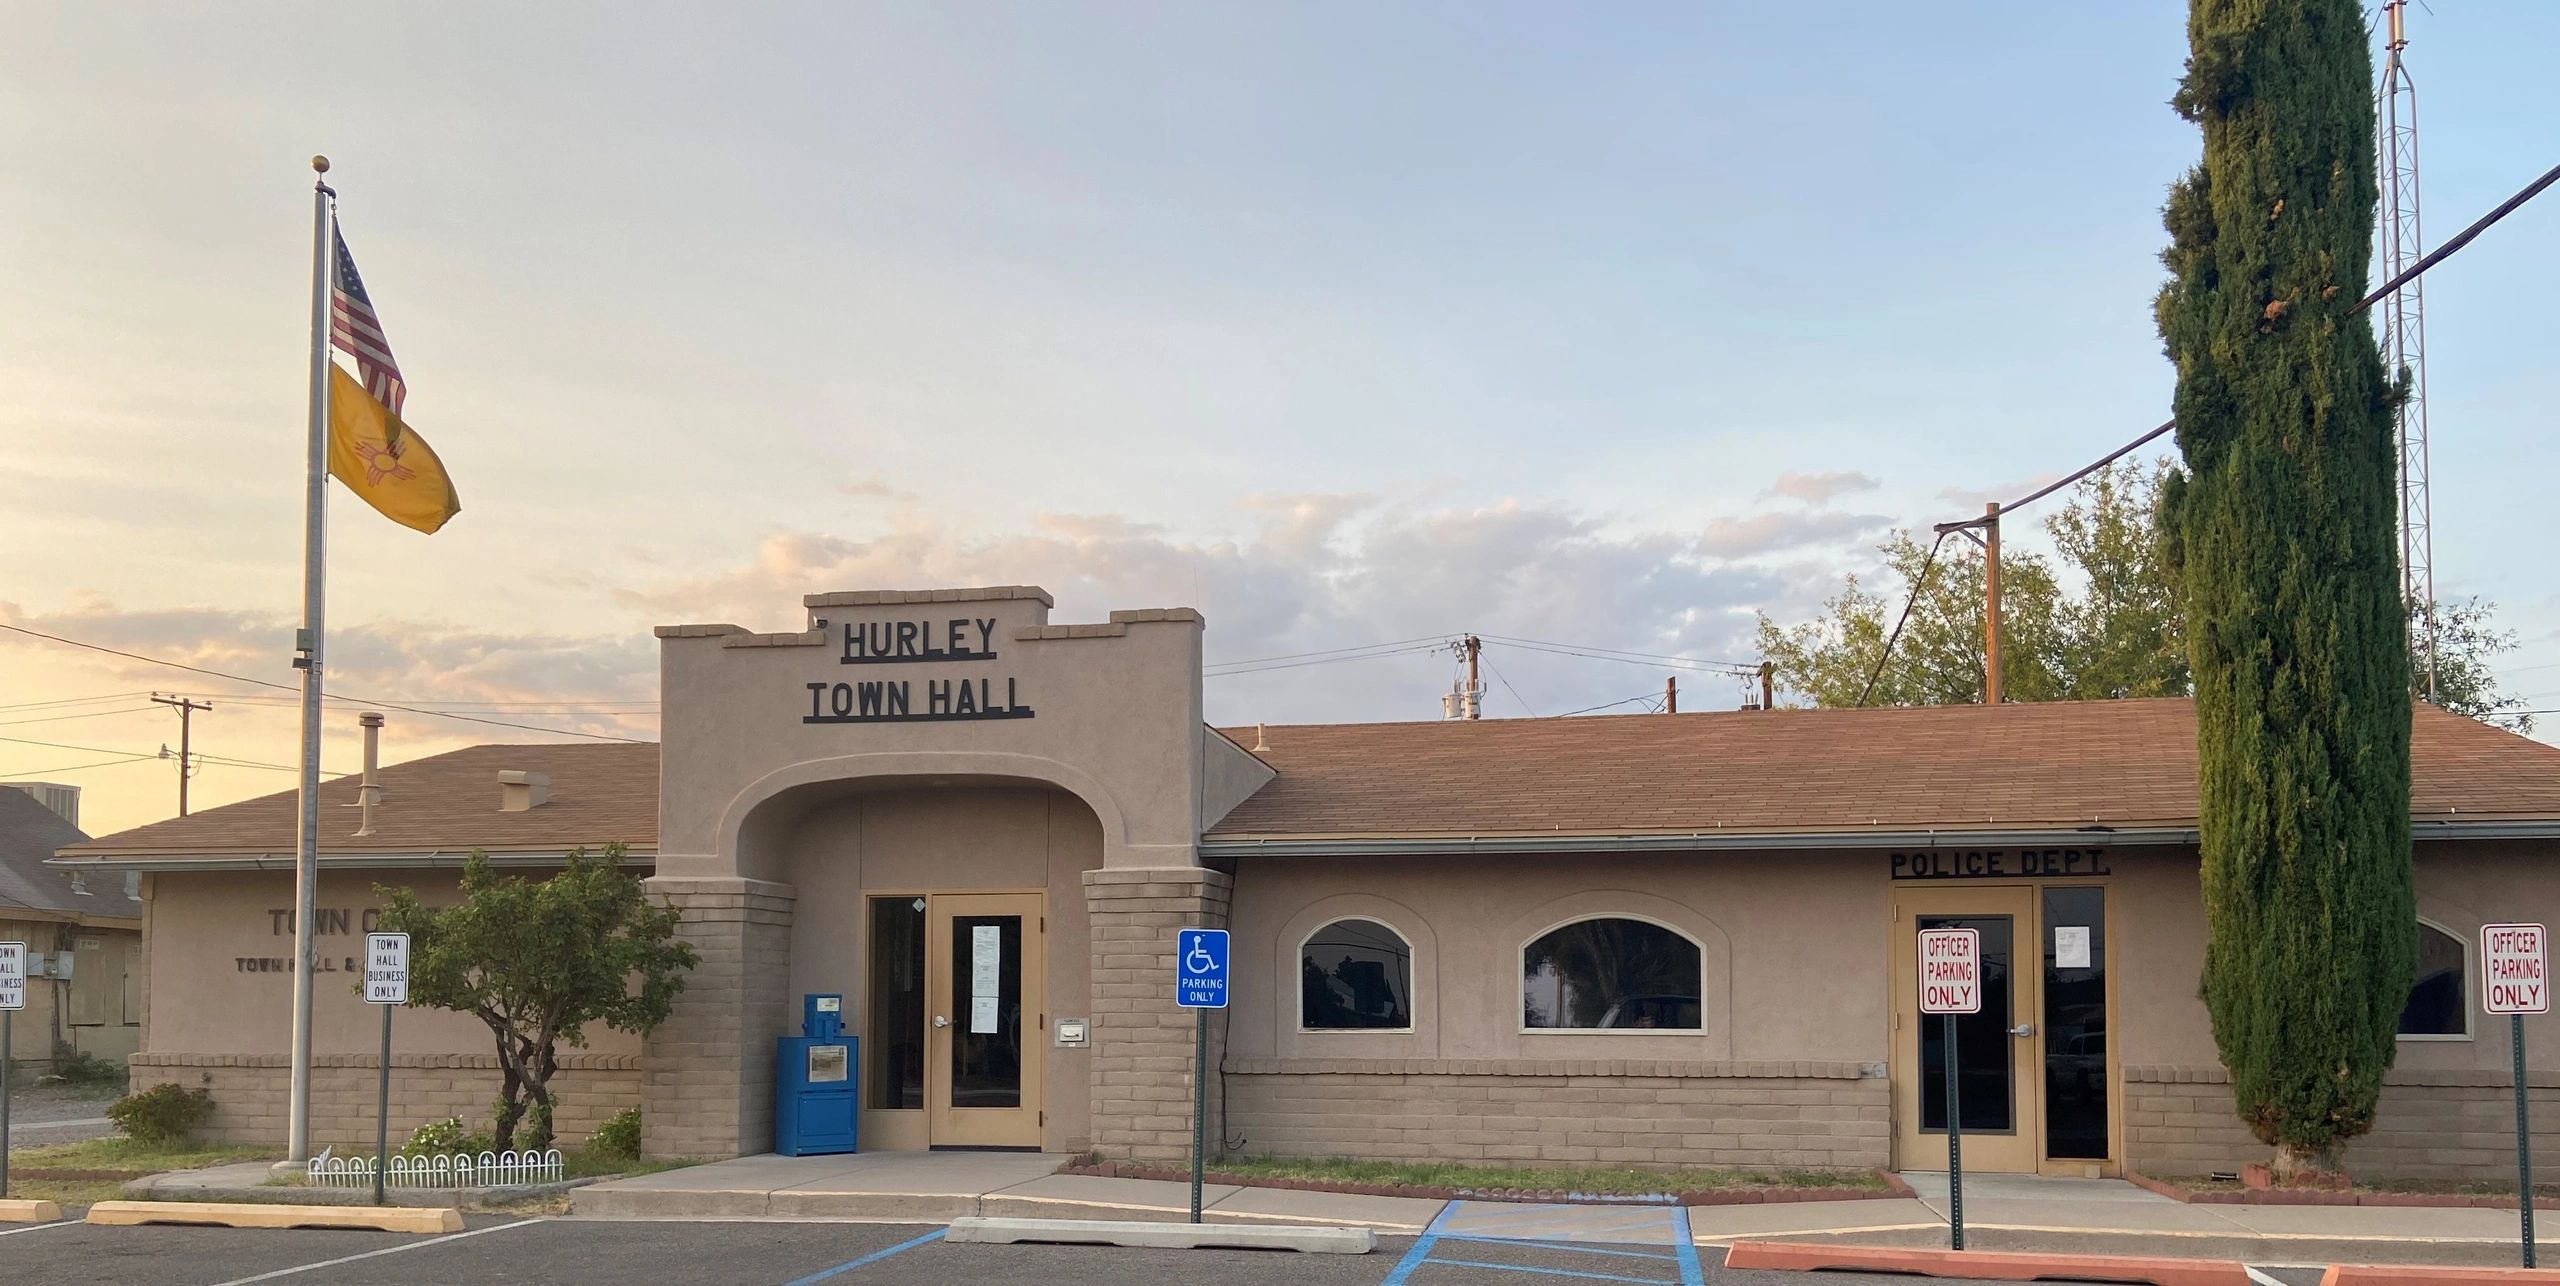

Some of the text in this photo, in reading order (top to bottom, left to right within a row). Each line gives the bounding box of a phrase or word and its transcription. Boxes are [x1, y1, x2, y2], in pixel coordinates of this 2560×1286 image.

[843, 618, 997, 660] HURLEY
[805, 677, 1032, 719] TOWN HALL
[1891, 850, 2111, 877] POLICE DEPT.
[376, 939, 399, 950] TOWN
[1928, 937, 1970, 957] OFFICER
[2492, 932, 2538, 954] OFFICER
[235, 957, 283, 972] TOWN
[376, 955, 398, 966] HALL
[2492, 958, 2541, 980] PARKING
[368, 970, 405, 982] BUSINESS
[1927, 961, 1973, 981] PARKING
[374, 986, 397, 998] ONLY
[1182, 978, 1224, 989] PARKING
[1190, 991, 1215, 1002] ONLY
[1927, 985, 1972, 1006] ONLY
[2492, 984, 2541, 1006] ONLY
